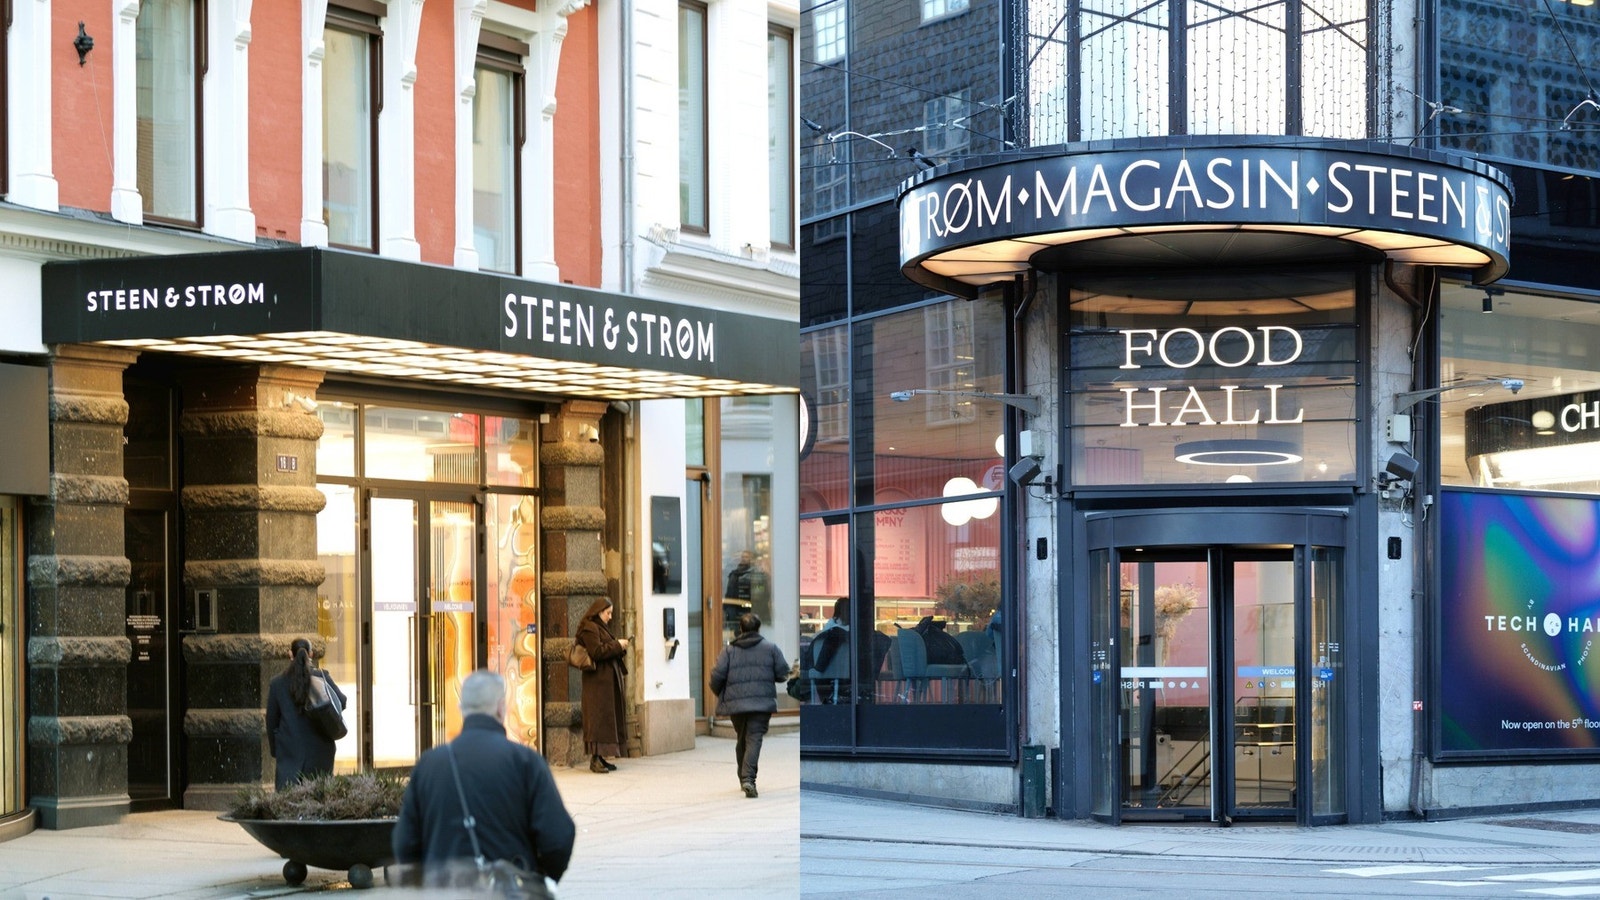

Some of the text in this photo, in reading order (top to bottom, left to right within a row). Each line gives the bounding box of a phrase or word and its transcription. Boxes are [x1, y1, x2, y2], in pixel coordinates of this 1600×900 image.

[905, 157, 1511, 252] TRØM MAGASIN STEEN & ST
[87, 282, 265, 312] STEEN & STRØM
[504, 293, 715, 363] STEEN & STRØM
[1119, 325, 1303, 369] FOOD
[1119, 384, 1304, 427] HALL
[1560, 401, 1600, 433] CH
[1485, 616, 1537, 631] TECH
[1521, 643, 1566, 671] SCANDINAVIAN
[1577, 640, 1592, 666] PHOTO
[1501, 719, 1521, 730] Now
[1522, 721, 1543, 732] open
[1545, 721, 1556, 729] on
[1557, 719, 1570, 729] the
